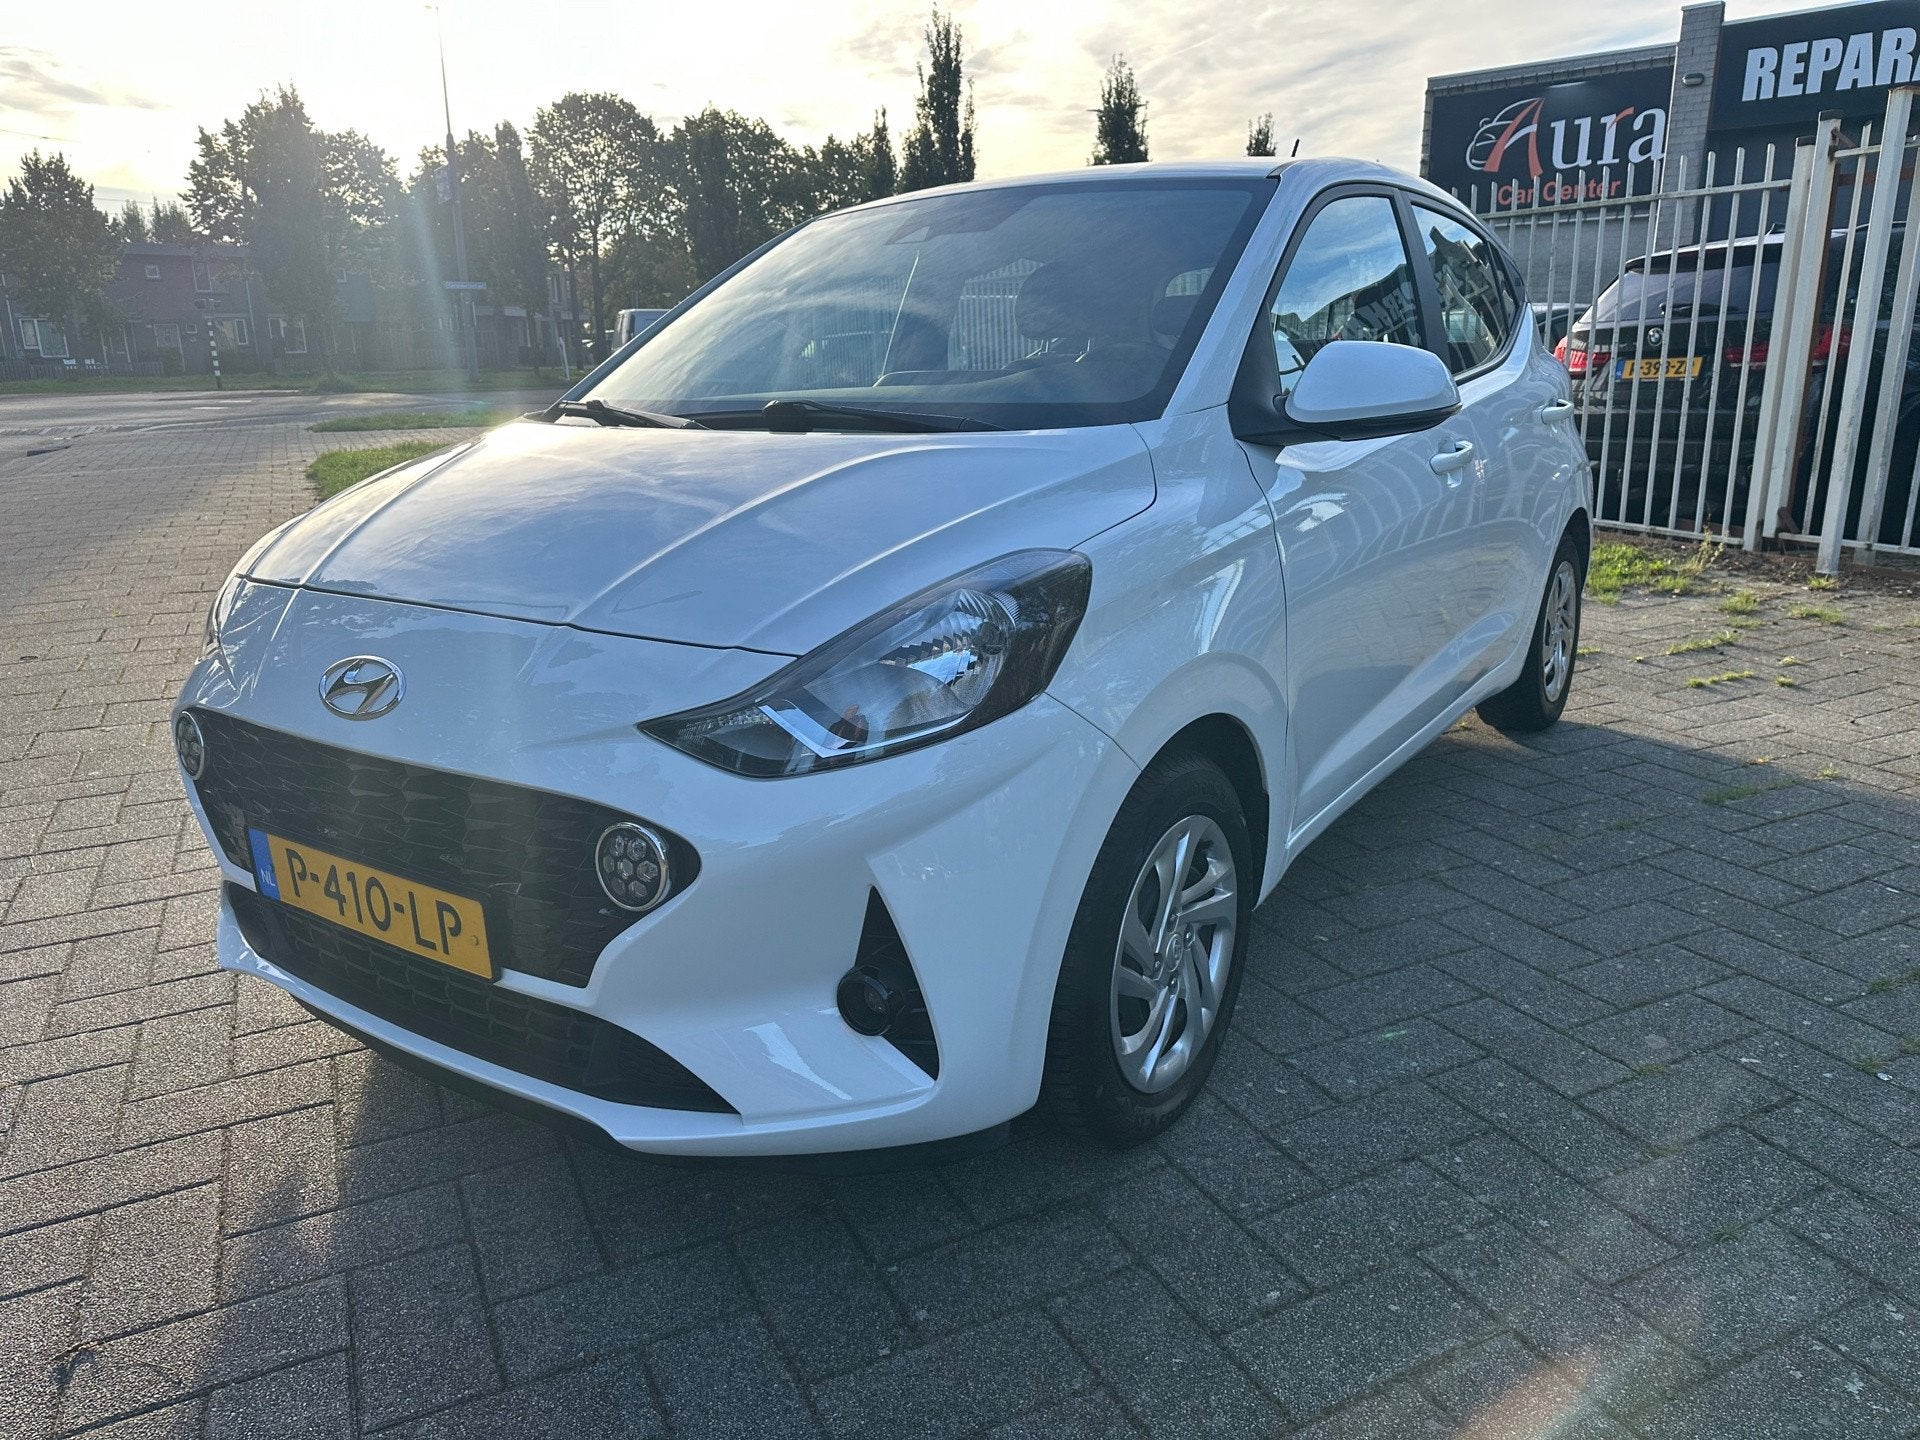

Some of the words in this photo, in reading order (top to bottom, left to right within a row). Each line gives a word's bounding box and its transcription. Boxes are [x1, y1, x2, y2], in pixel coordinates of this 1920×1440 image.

[1742, 27, 1920, 101] REPAR
[1483, 97, 1665, 179] Aura
[261, 868, 276, 888] NL
[285, 848, 462, 955] P-410-LP
